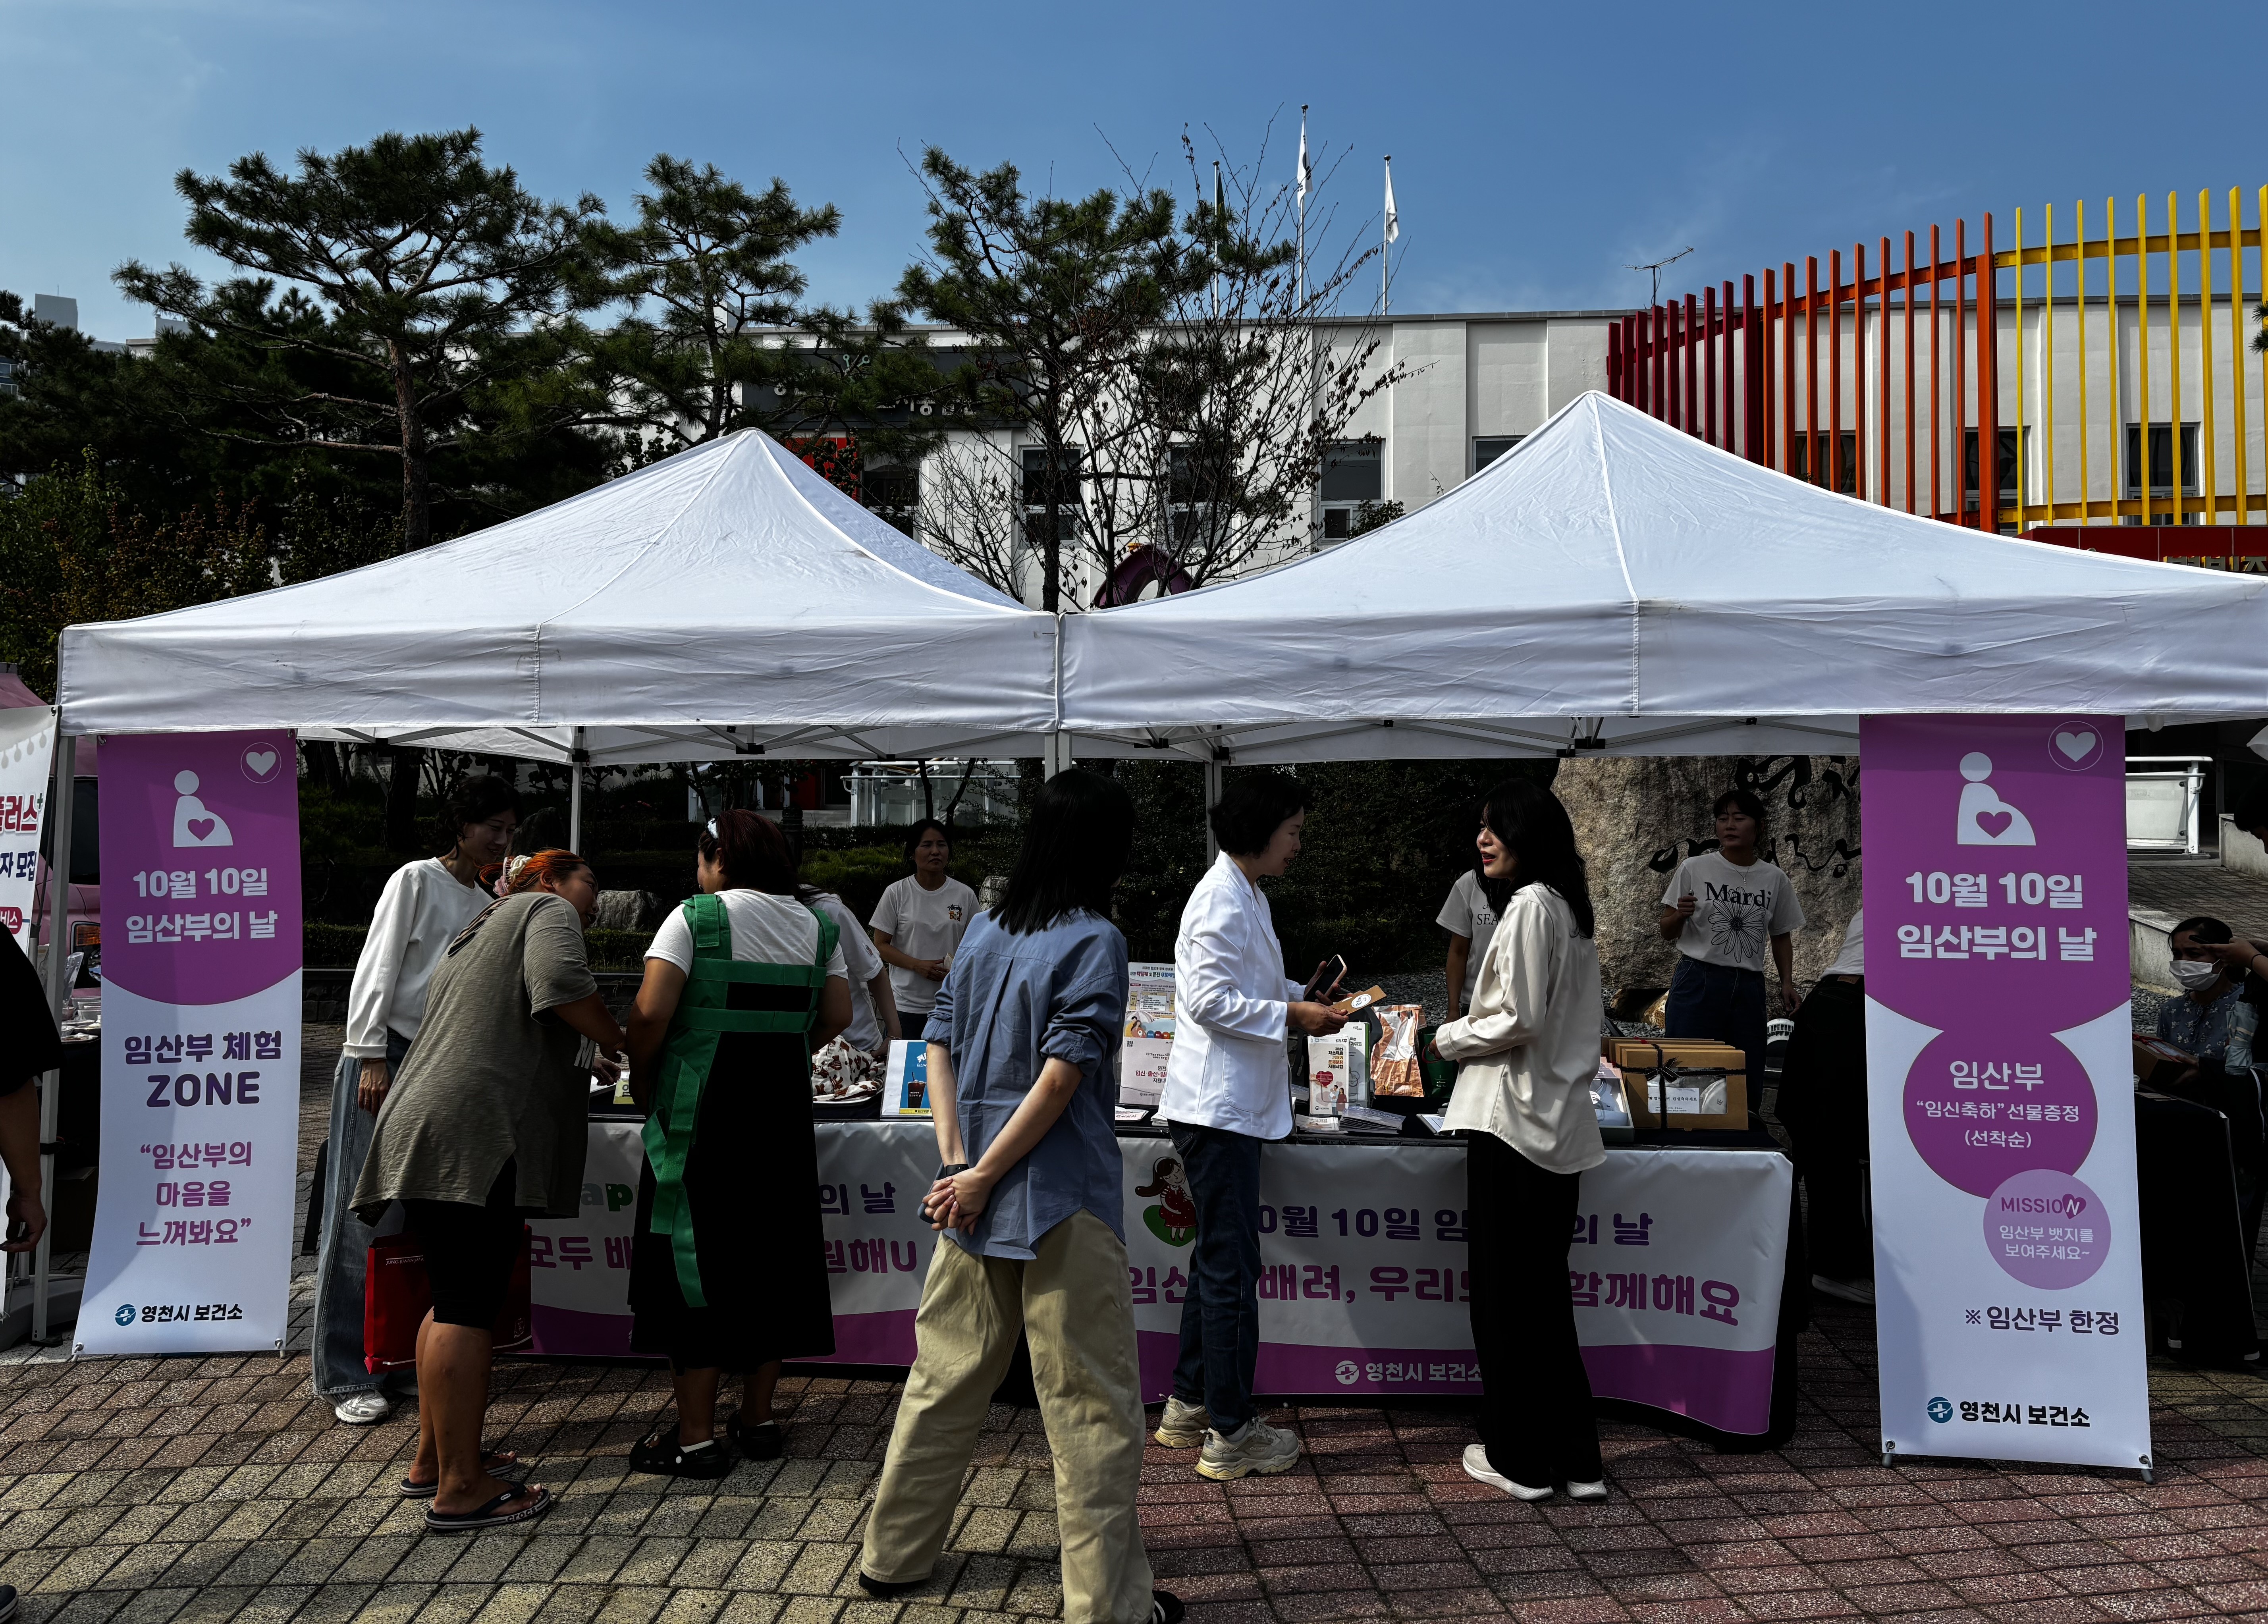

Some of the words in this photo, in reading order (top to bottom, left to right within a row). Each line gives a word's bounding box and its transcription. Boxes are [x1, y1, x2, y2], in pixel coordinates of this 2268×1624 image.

[16, 851, 37, 881] 모집
[133, 870, 197, 899] 10월
[204, 868, 268, 896] 10일
[1704, 882, 1771, 910] Mardi
[1905, 871, 1988, 907] 10월
[1998, 872, 2083, 908] 10일
[126, 912, 239, 943] 임산부의
[249, 910, 278, 939] 날
[1897, 925, 2046, 960] 임산부의
[2059, 927, 2097, 961] 날
[124, 1033, 213, 1065] 임산부
[222, 1030, 282, 1061] 체험
[147, 1071, 260, 1108] ZONE
[1950, 1061, 2044, 1091] 임산부
[2006, 1103, 2080, 1123] 선물증정
[1964, 1129, 2033, 1149] (선착순)
[140, 1141, 253, 1170] “임산부의
[156, 1180, 231, 1207] 마음을
[860, 1182, 896, 1214] 날
[2001, 1196, 2080, 1216] MISSION
[136, 1217, 252, 1246] 느껴봐요”
[1331, 1207, 1421, 1241] 10일
[1613, 1212, 1653, 1246] 날
[1999, 1225, 2045, 1242] 임산부
[2048, 1226, 2094, 1243] 뱃지를
[2005, 1244, 2091, 1260] 보여주세요~
[141, 1305, 190, 1323] 영천시
[193, 1303, 243, 1322] 보건소
[1986, 1306, 2062, 1332] 임산부
[2069, 1310, 2120, 1335] 한정
[1365, 1363, 1423, 1382] 영천시
[1430, 1363, 1482, 1382] 보건소
[1959, 1401, 2022, 1425] 영천시
[2028, 1405, 2091, 1427] 보건소
